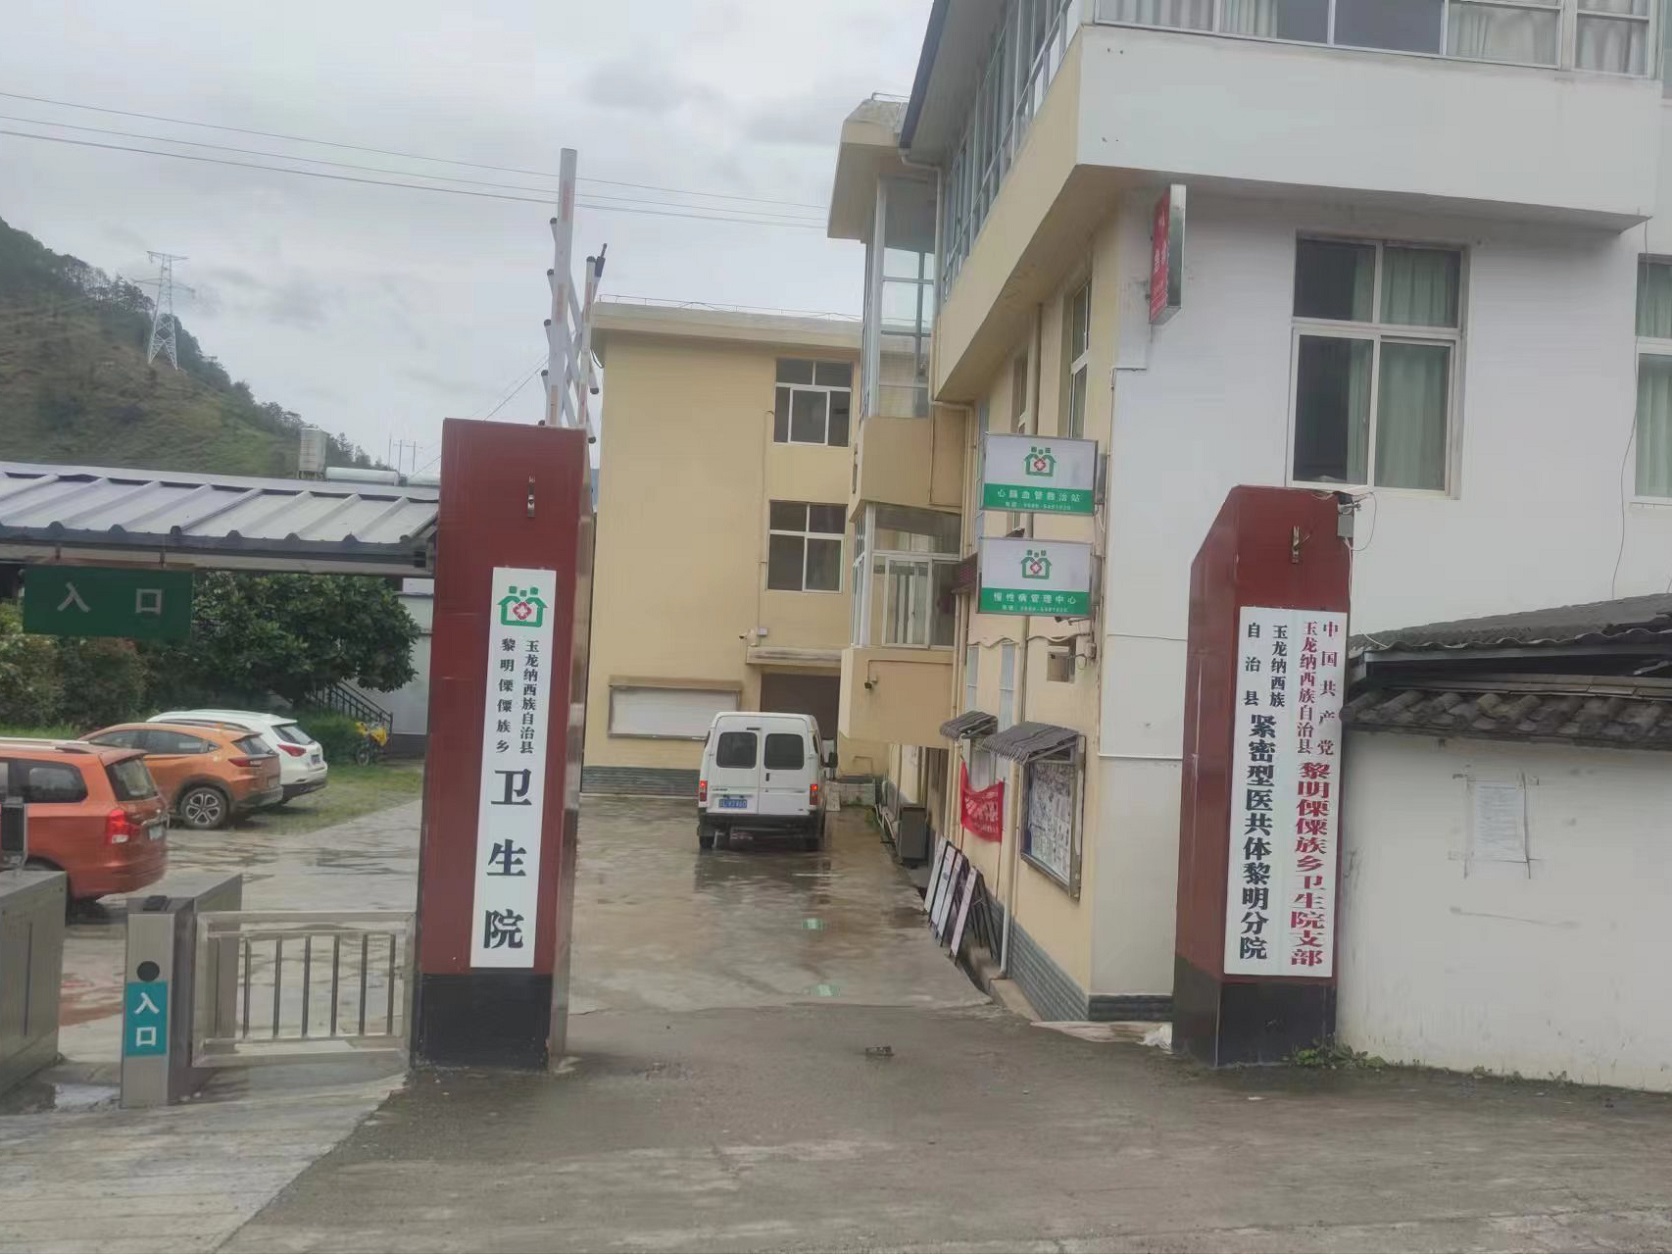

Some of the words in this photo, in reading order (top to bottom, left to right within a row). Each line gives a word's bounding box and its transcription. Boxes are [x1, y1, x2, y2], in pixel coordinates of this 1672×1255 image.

[57, 582, 162, 614] 入口
[496, 638, 516, 753] 黎明傈僳族乡
[520, 640, 539, 754] 玉龙纳西族自治县
[1243, 622, 1262, 706] 自治县
[1269, 625, 1288, 708] 玉龙纳西族
[1297, 621, 1318, 754] 玉龙纳西族自治县
[1317, 621, 1338, 756] 中国共产党
[483, 768, 532, 949] 卫生院
[1239, 714, 1277, 960] 紧密型医共体黎明分院
[134, 992, 160, 1047] 入口
